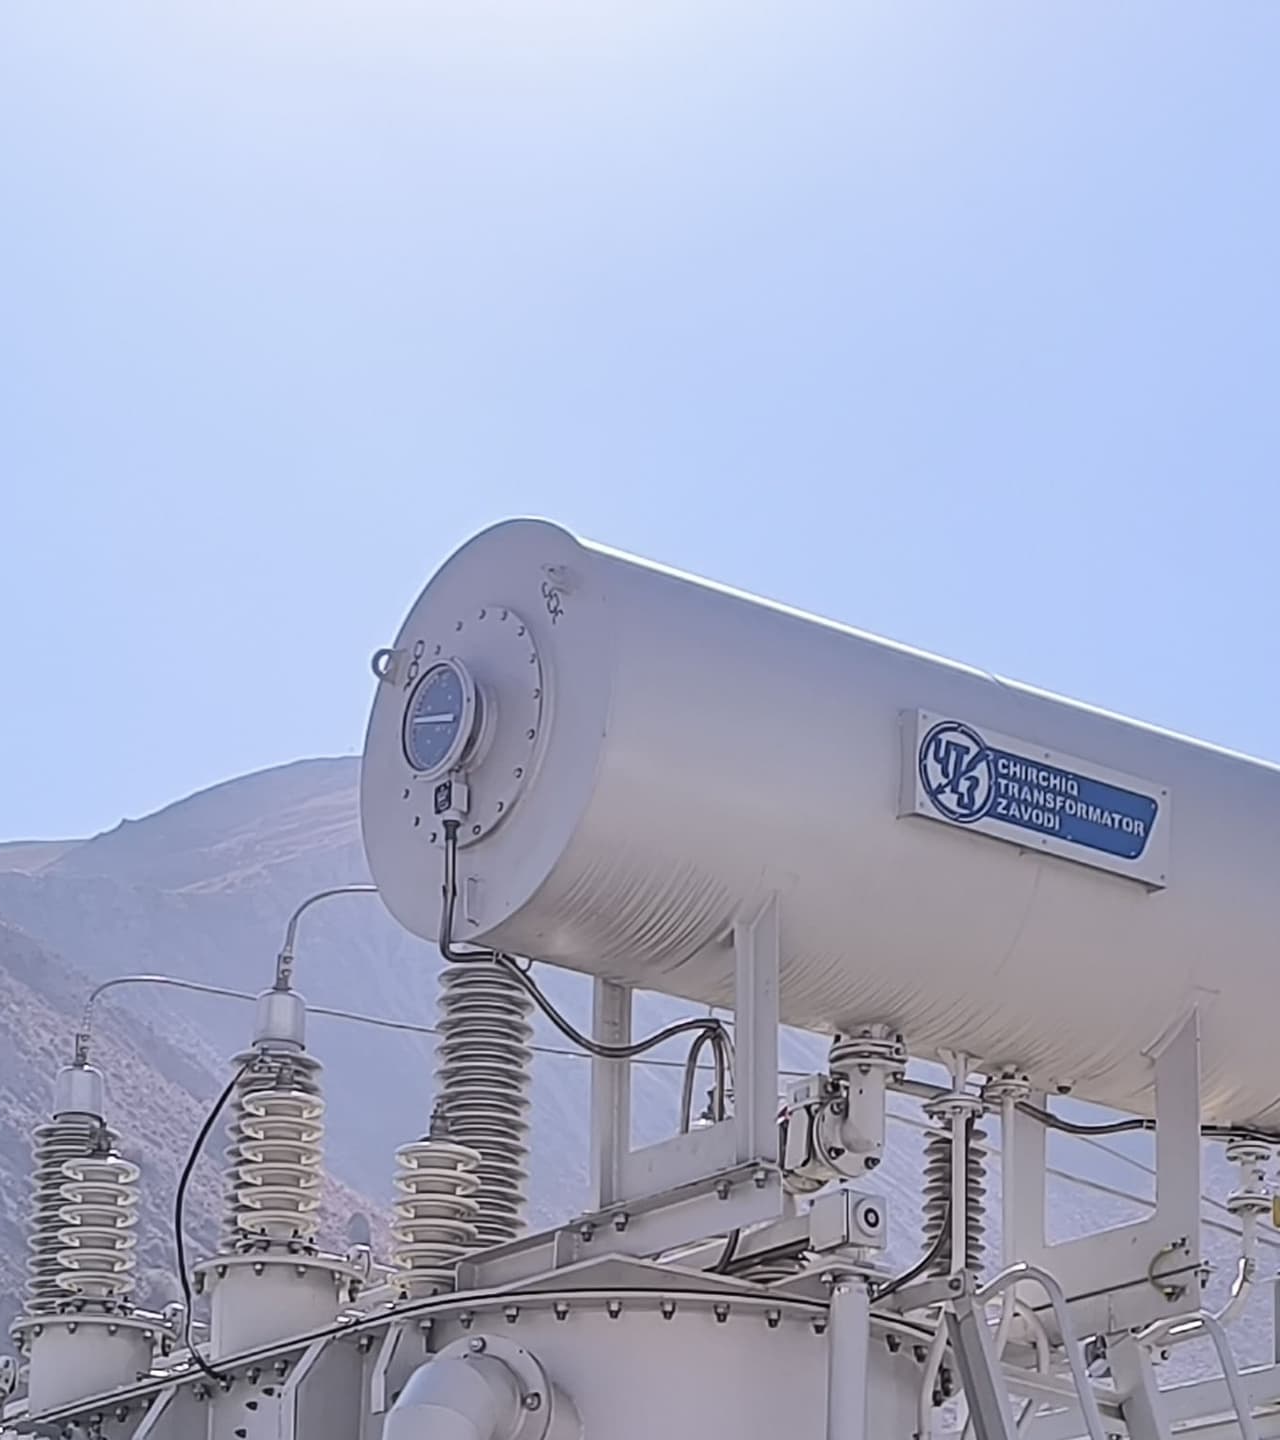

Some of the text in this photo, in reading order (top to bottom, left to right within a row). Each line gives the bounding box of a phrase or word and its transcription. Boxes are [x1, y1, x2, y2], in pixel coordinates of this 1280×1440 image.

[997, 758, 1079, 796] CHIRCHIQ
[996, 798, 1061, 831] ZAVODI
[997, 778, 1145, 837] TRANSFORMATOR
